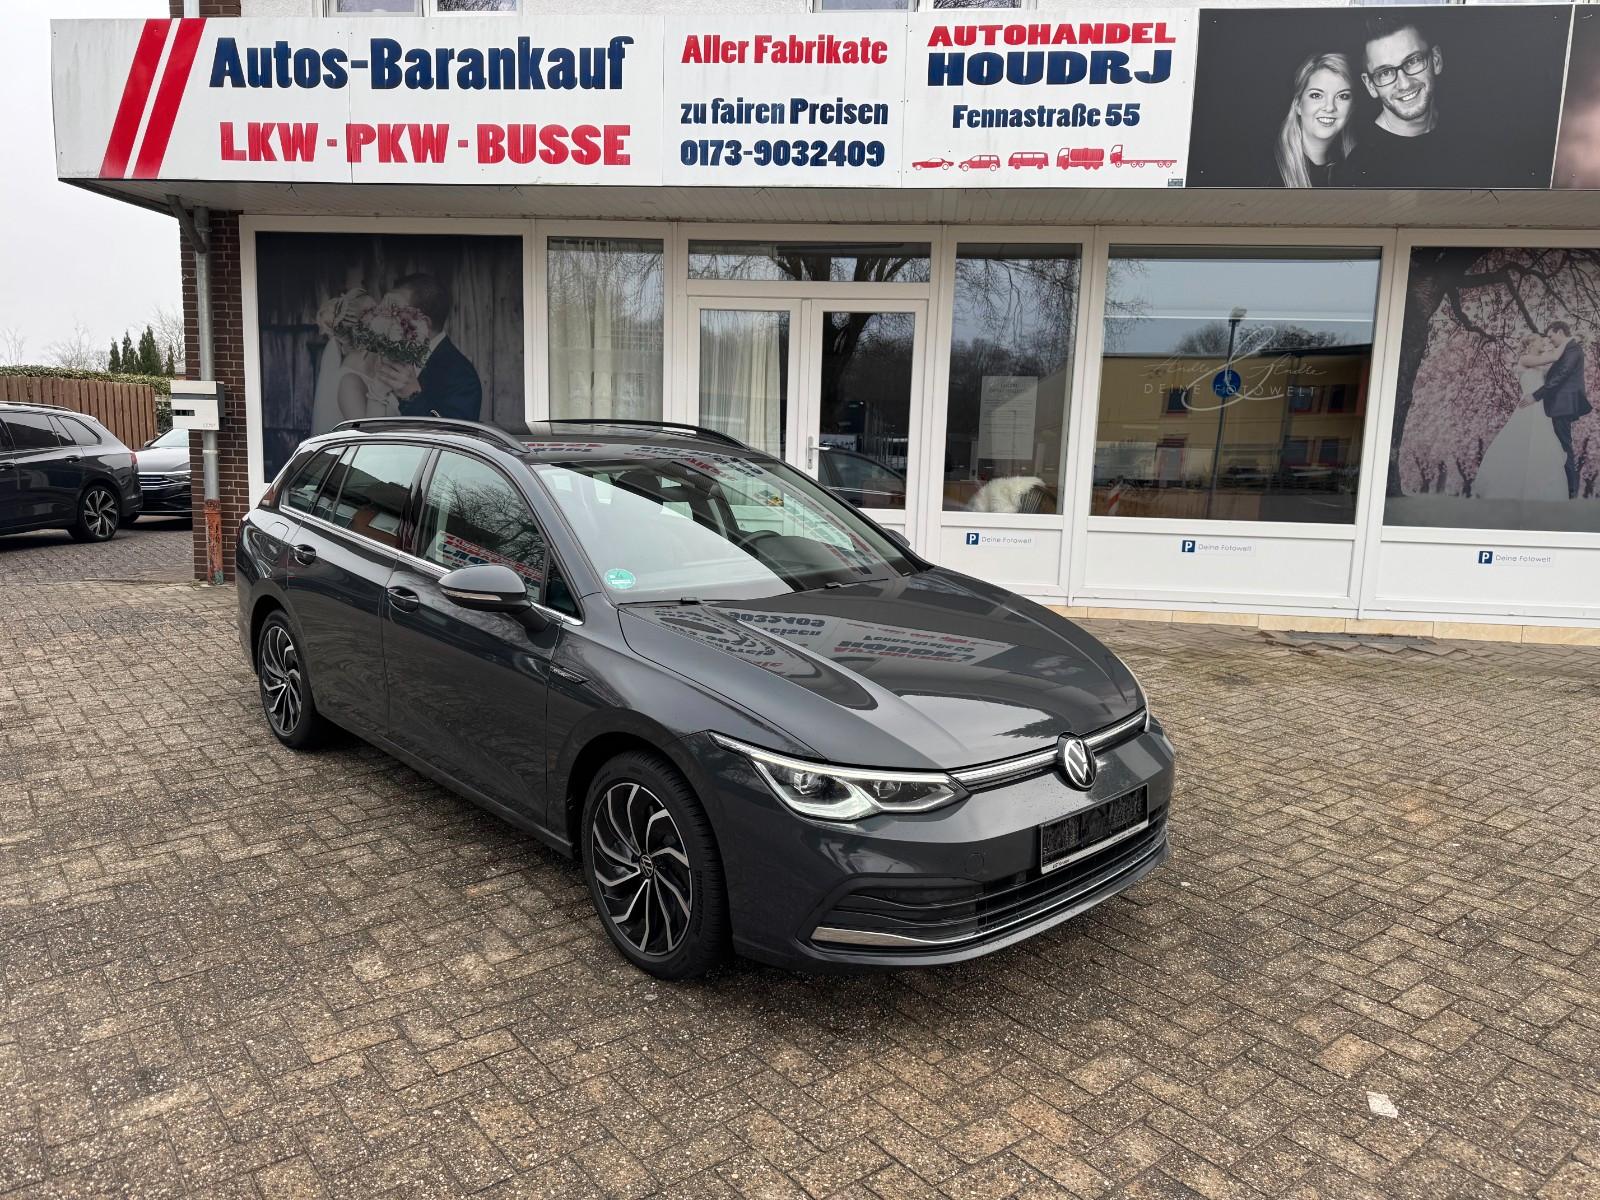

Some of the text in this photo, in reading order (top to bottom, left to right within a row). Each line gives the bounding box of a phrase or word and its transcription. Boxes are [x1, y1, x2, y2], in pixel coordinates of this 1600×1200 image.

[681, 34, 888, 65] Aller Fabrikate
[927, 22, 1176, 48] AUTOHANDEL
[209, 36, 634, 91] Autos-Barankauf
[927, 49, 1172, 87] HOUDRJ
[680, 97, 889, 125] zu fairen Preisen
[952, 103, 1141, 129] Fennastraße 55
[219, 122, 319, 163] LKW
[347, 123, 449, 164] PKW
[477, 124, 631, 166] BUSSE
[680, 139, 885, 168] 0173-9032409
[1144, 383, 1201, 394] DEINE
